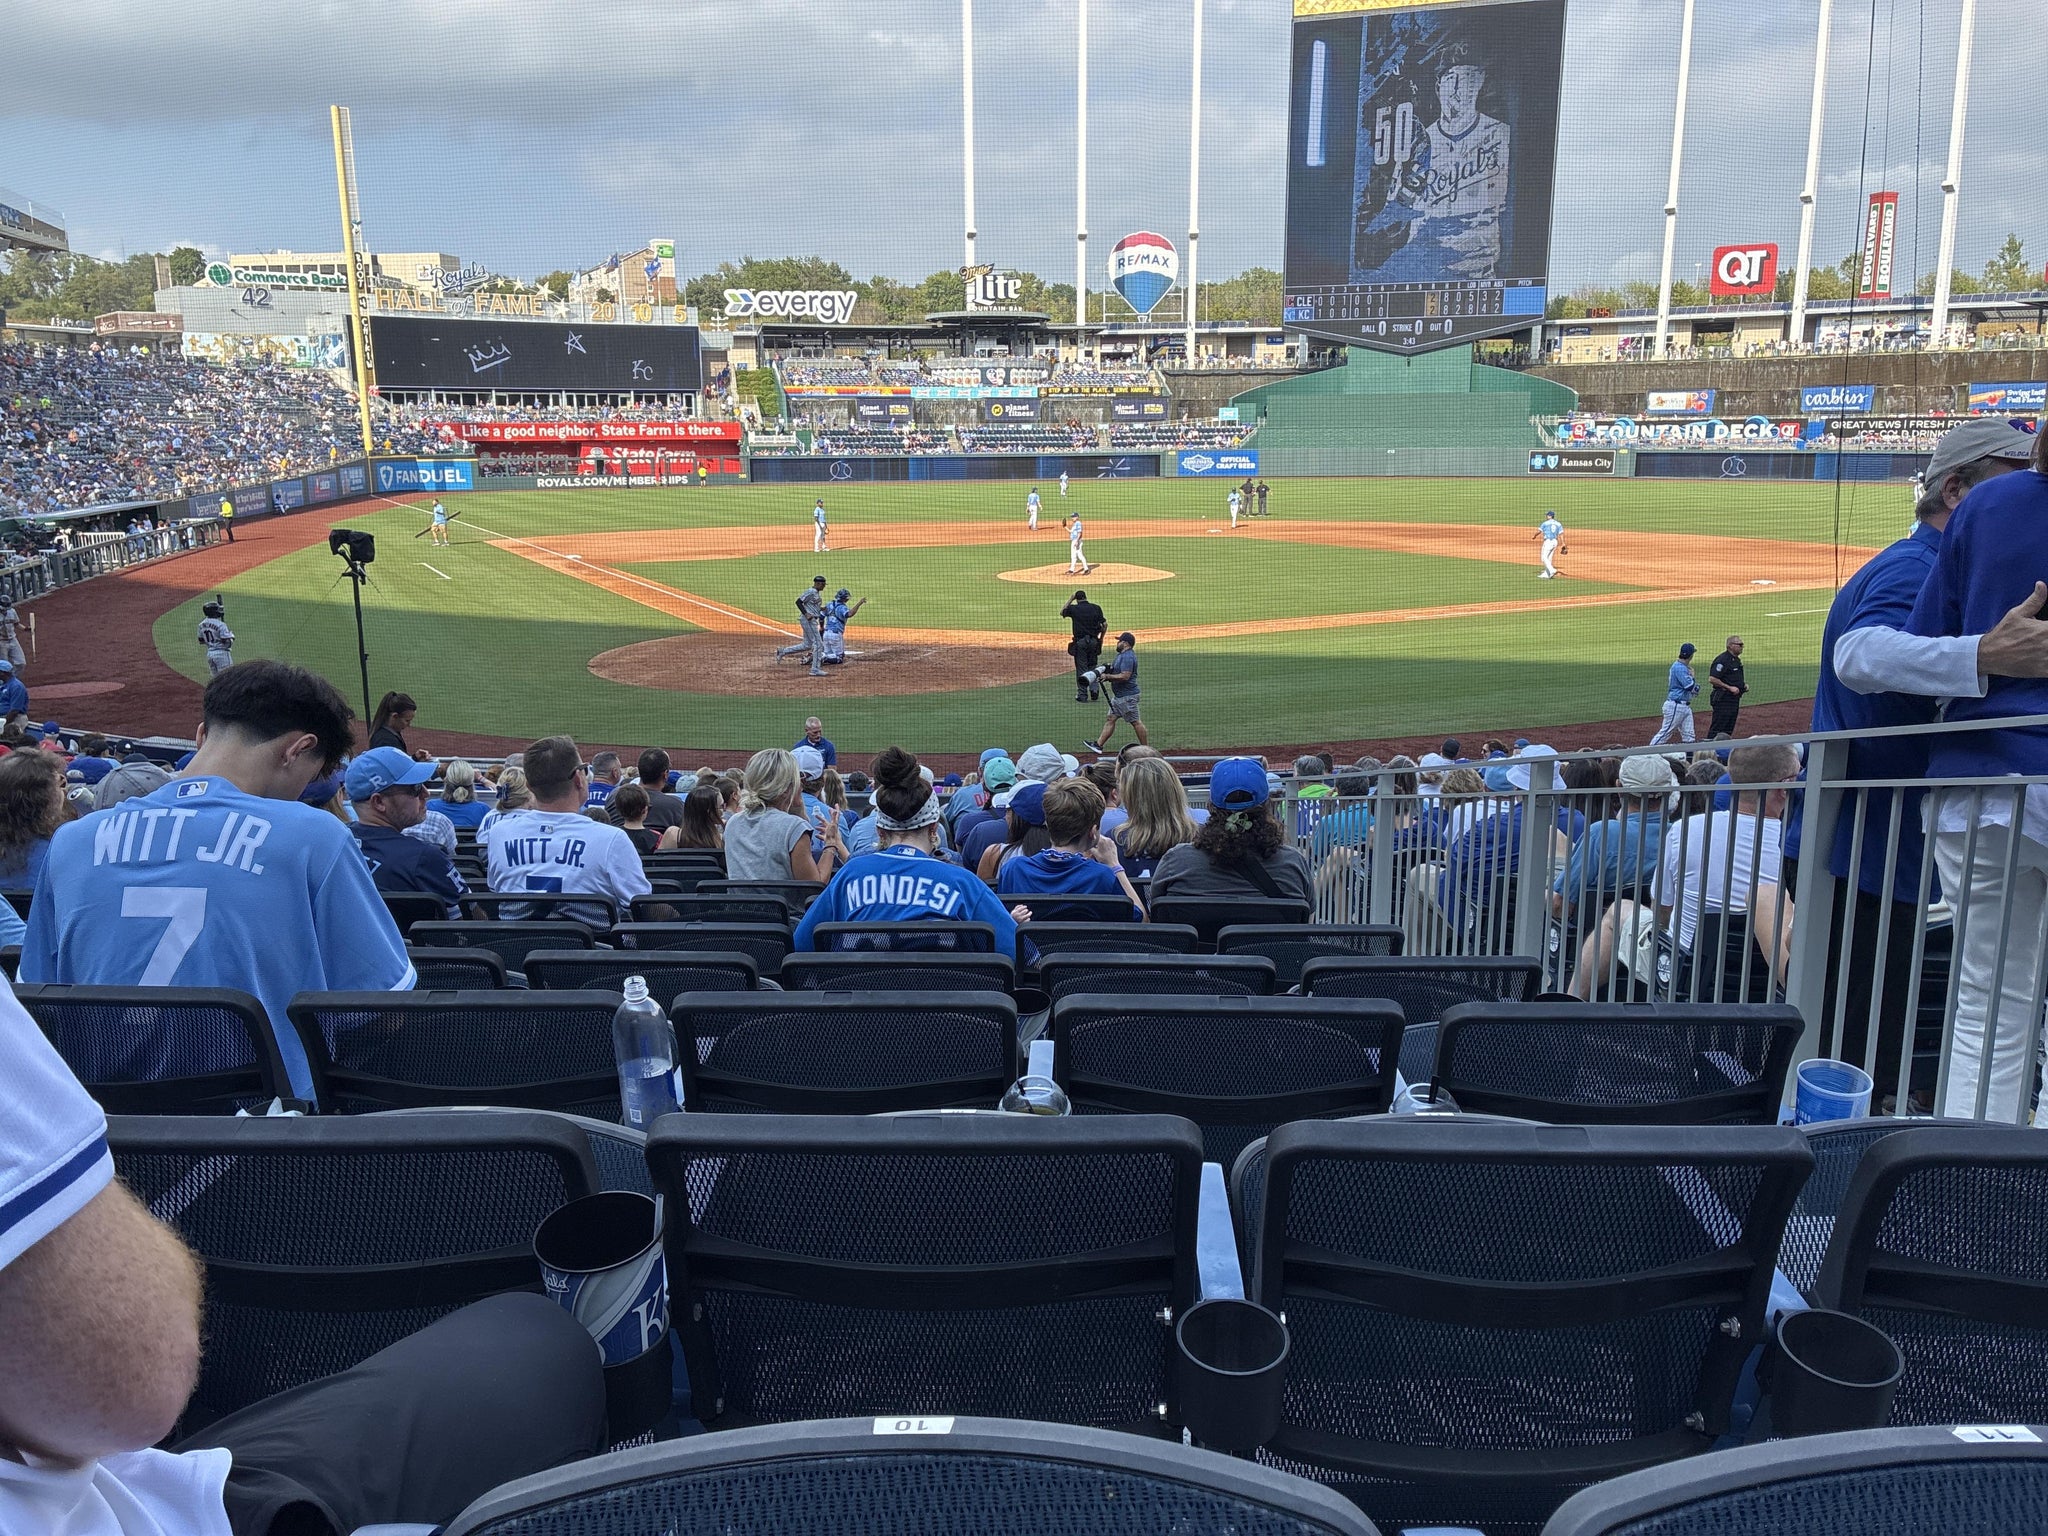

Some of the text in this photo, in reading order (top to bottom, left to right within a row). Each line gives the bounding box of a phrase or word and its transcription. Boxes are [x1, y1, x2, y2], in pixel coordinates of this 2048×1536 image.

[1374, 101, 1414, 165] 50
[1424, 141, 1501, 206] Royals
[1861, 208, 1879, 286] BOULEVARD
[1879, 207, 1895, 286] BOULEVARD
[1118, 254, 1170, 269] RE/MAX
[1718, 250, 1769, 287] QT
[234, 269, 345, 286] Commerce Bank
[430, 261, 488, 292] Royals
[959, 263, 995, 283] Miller
[242, 287, 271, 307] 42
[972, 275, 1022, 306] Lite
[375, 288, 546, 317] HALL of FAME
[758, 292, 854, 321] evergy
[1296, 296, 1313, 307] CLE
[591, 302, 615, 321] 20
[632, 303, 652, 322] 10
[673, 304, 687, 322] 5
[1298, 309, 1310, 319] KC
[1592, 308, 1610, 318] 0:45
[1361, 318, 1453, 336] BALL 0 STRIKE 0 OUT 0
[1402, 337, 1416, 345] 3:43
[632, 359, 654, 381] KC
[1805, 388, 1869, 406] carbliss
[2007, 389, 2030, 397] Swing
[1005, 404, 1030, 412] planet
[462, 424, 725, 440] Like a good neighbor, State Farm is there.
[1596, 424, 1708, 439] FOUNTAIN
[1713, 423, 1776, 439] DECK
[1831, 420, 1970, 429] GREAT VIEWS FRESH FOO
[1562, 458, 1612, 468] Kansas City
[395, 469, 466, 483] FANDUEL
[94, 808, 272, 876] WITT JR.
[505, 838, 586, 869] WITT JR.
[847, 874, 961, 916] MONDESI
[121, 886, 208, 987] 7
[895, 1420, 928, 1431] 10
